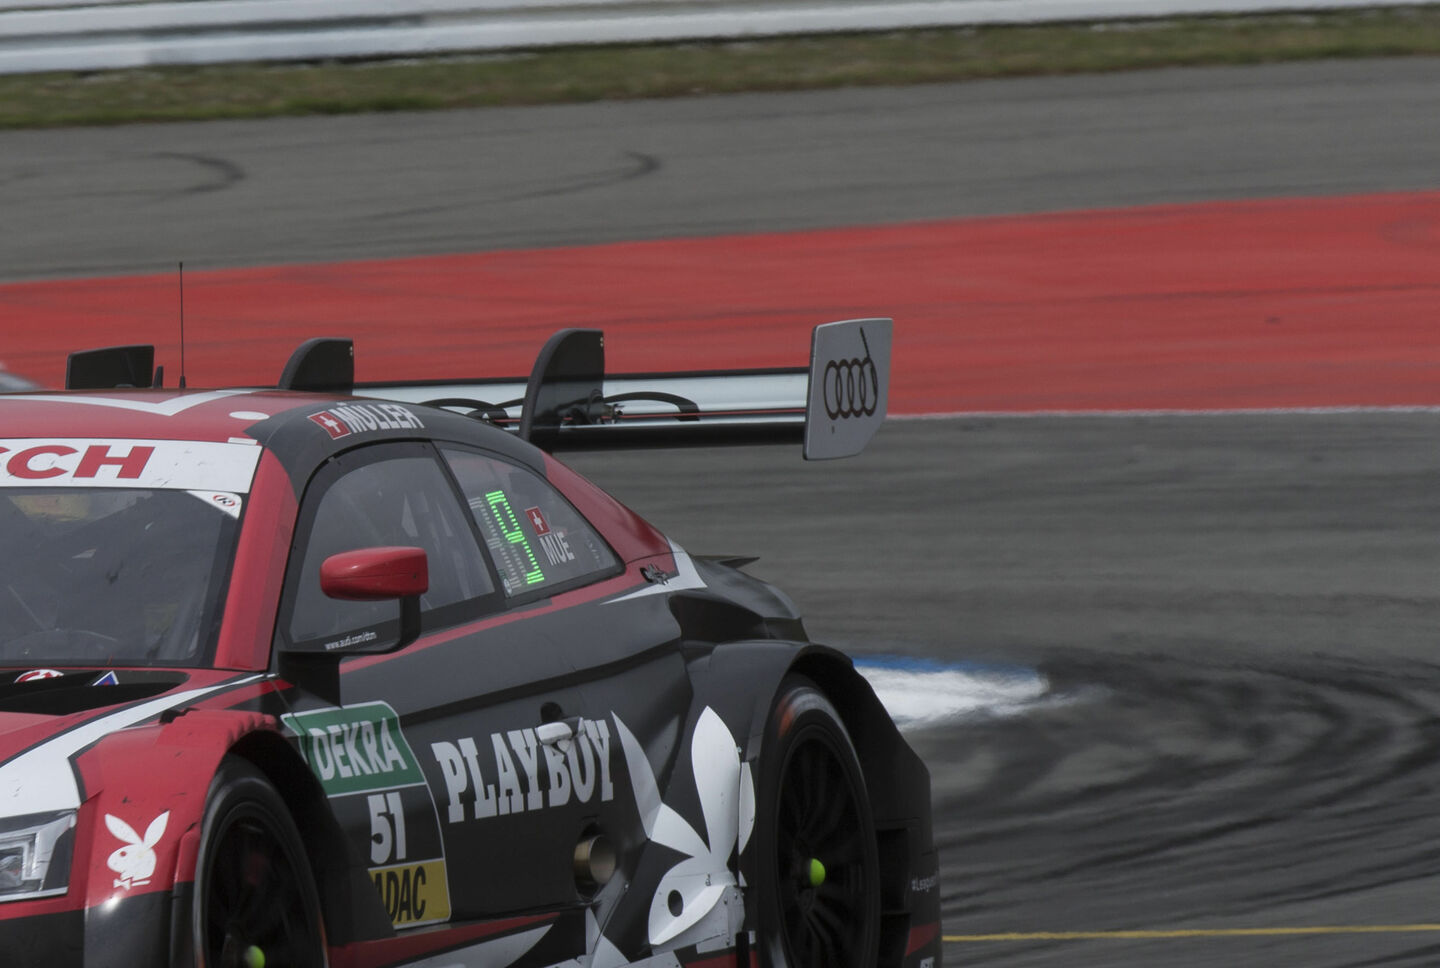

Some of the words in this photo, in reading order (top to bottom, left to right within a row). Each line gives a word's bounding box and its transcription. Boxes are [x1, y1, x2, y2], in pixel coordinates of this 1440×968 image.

[328, 401, 425, 434] MÜLLER
[539, 532, 575, 566] MUE
[309, 717, 408, 780] DEKRA
[431, 719, 614, 823] PLAYBOY
[367, 792, 406, 865] 51
